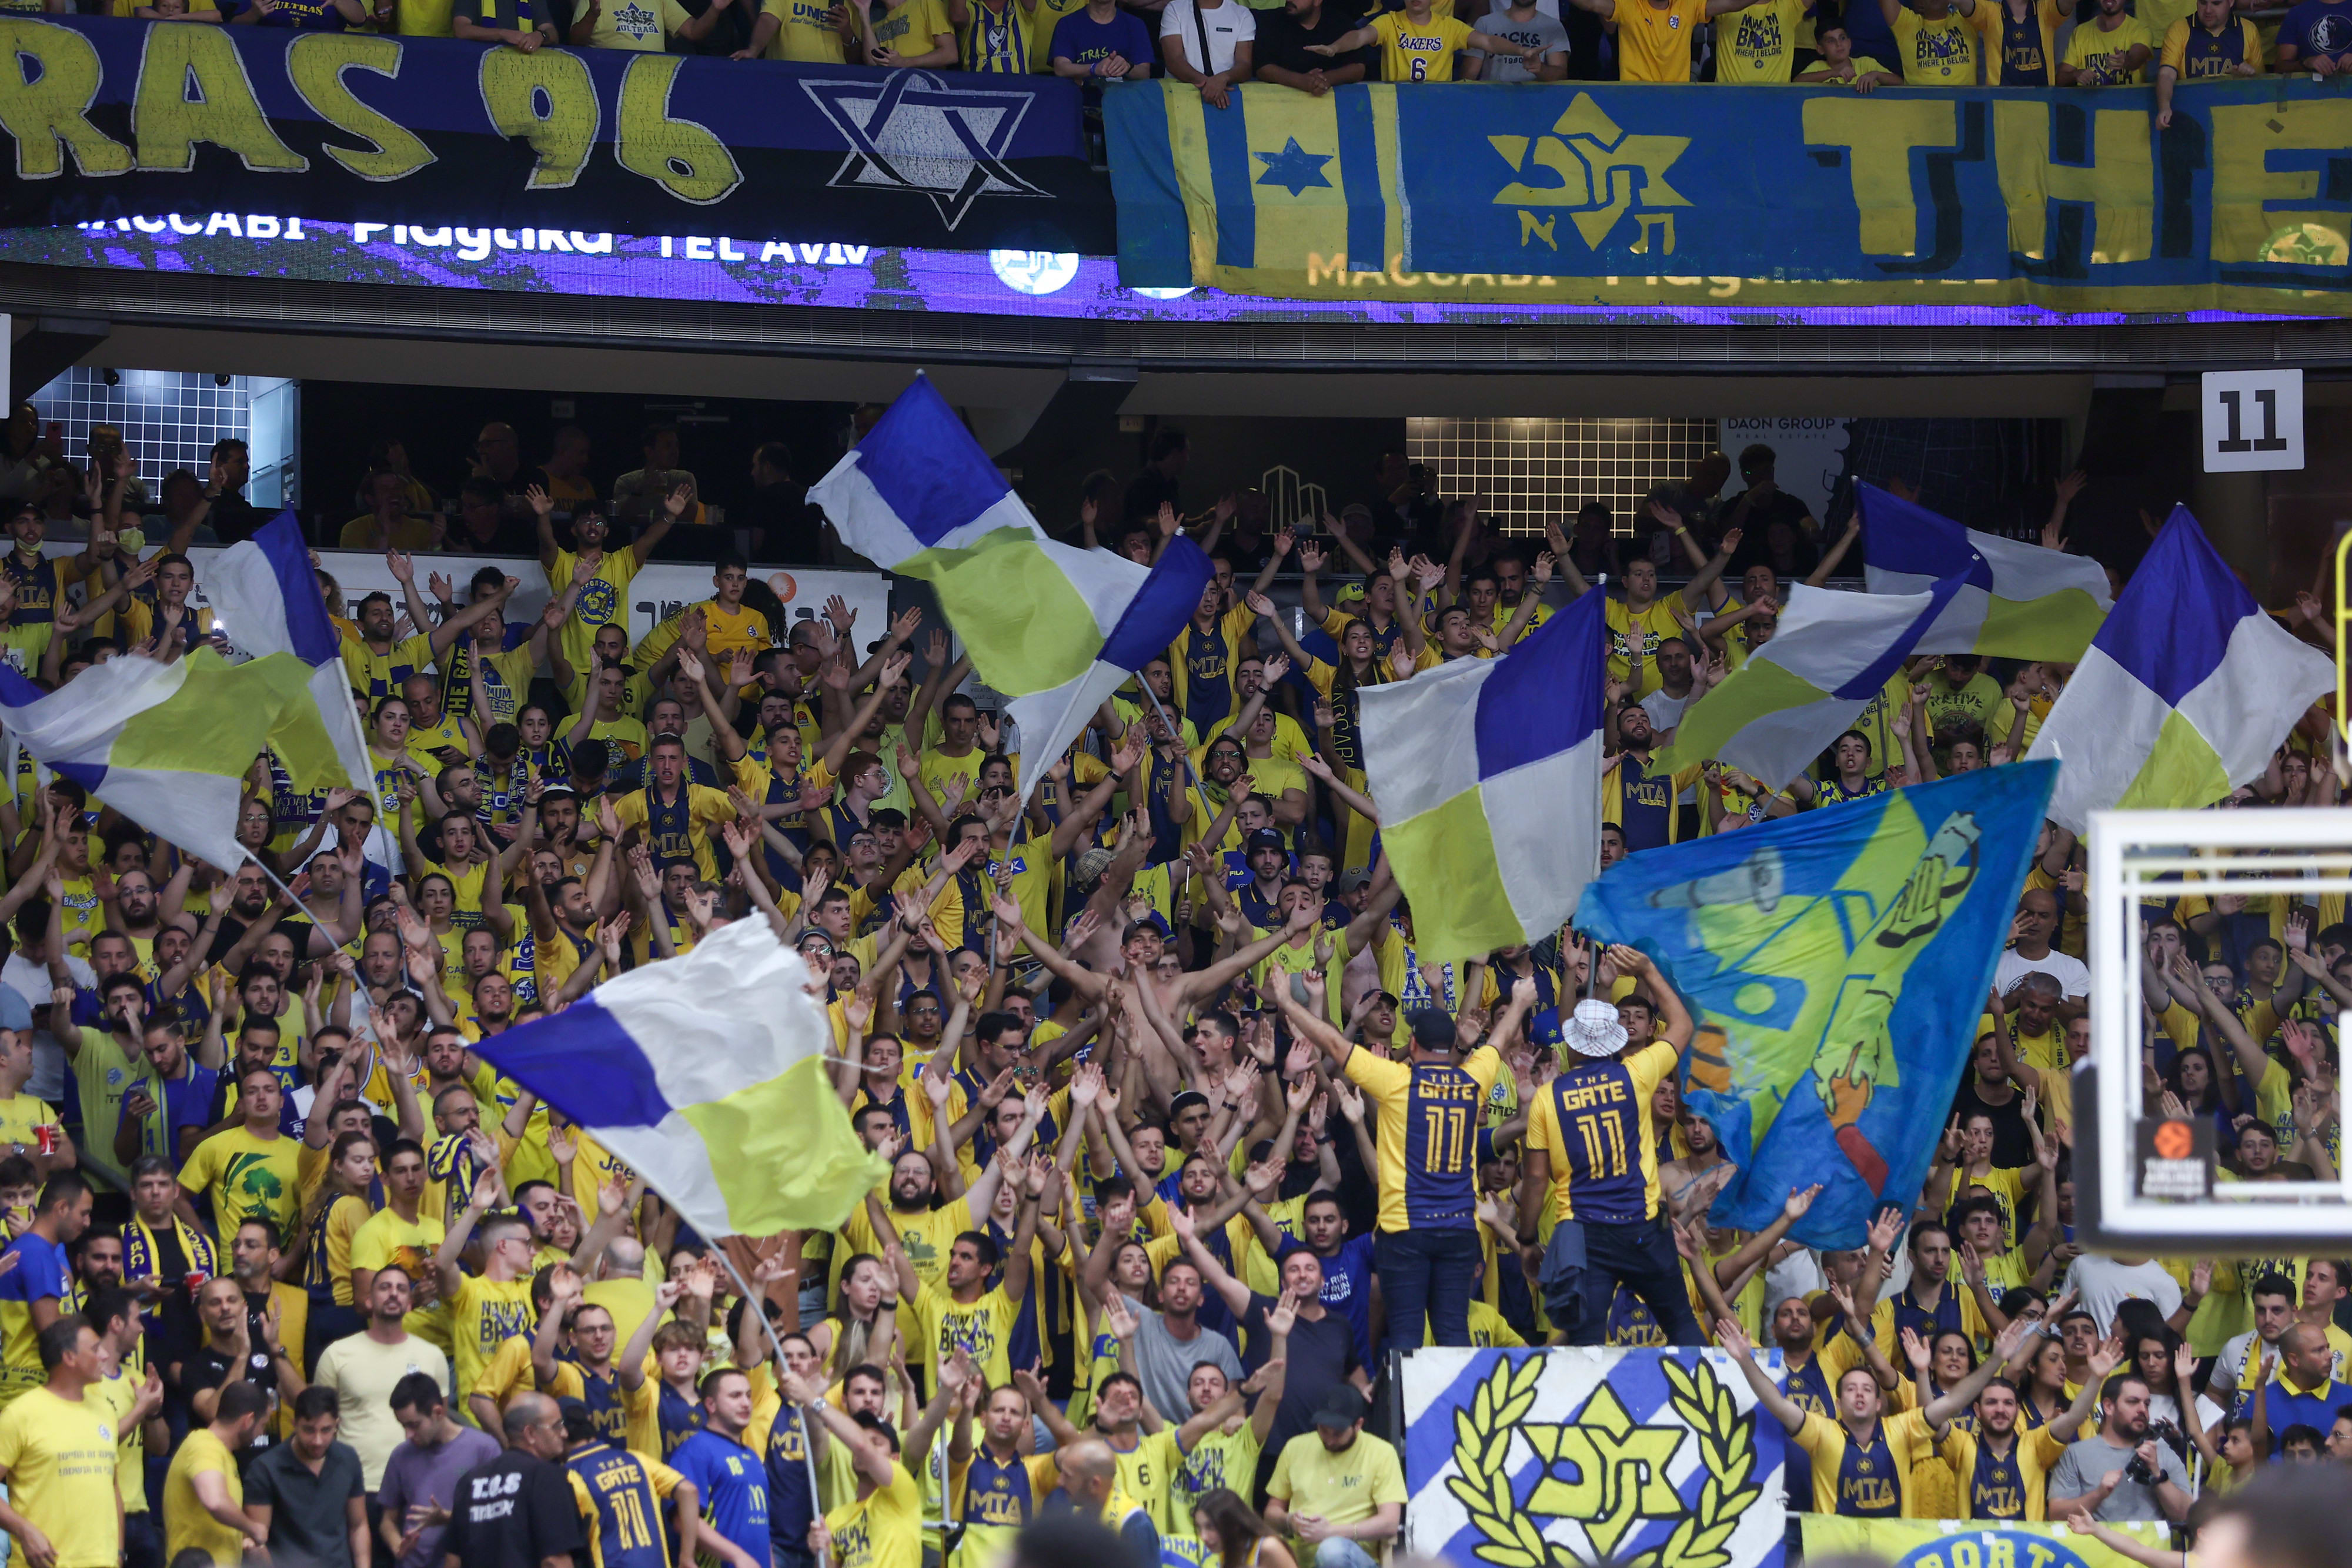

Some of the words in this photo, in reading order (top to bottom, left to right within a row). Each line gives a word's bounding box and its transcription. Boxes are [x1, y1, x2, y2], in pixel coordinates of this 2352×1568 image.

[275, 1, 323, 16] ULTRAS
[620, 25, 654, 33] ULTRAS
[1736, 26, 1782, 48] BACK
[1397, 32, 1443, 51] LAKERS
[1760, 46, 1782, 57] BELONG
[1916, 37, 1969, 59] BACK
[1077, 46, 1109, 63] TRAS
[1917, 59, 1940, 69] WHERE
[1946, 56, 1970, 65] BELONG
[2005, 46, 2042, 64] MTA
[1411, 56, 1427, 82] 6
[2191, 57, 2233, 76] MTA
[478, 45, 745, 206] 96
[1801, 96, 2352, 265] THE
[76, 212, 306, 240] CCABI
[1728, 419, 1772, 429] DAON
[1778, 419, 1835, 429] GROUP
[2218, 389, 2287, 453] 11
[1188, 656, 1227, 673] MTA
[448, 685, 469, 718] THE
[1865, 700, 1890, 715] BELNG
[1332, 691, 1355, 763] ACCABI
[1625, 781, 1668, 801] MTA
[649, 833, 690, 853] MTA
[988, 860, 1023, 875] FX
[1403, 998, 1458, 1013] MACBI
[1418, 1079, 1476, 1101] GATE
[1430, 1074, 1461, 1084] THE
[1574, 1074, 1609, 1086] THE
[1562, 1080, 1627, 1111] GATE
[1425, 1105, 1466, 1174] 11
[1576, 1110, 1628, 1179] 11
[599, 1155, 636, 1181] Jee
[1329, 1272, 1348, 1285] RUN
[1331, 1281, 1351, 1293] RUN
[1329, 1289, 1351, 1302] RUN
[1616, 1324, 1669, 1347] MTA
[593, 1407, 626, 1432] MT
[771, 1430, 804, 1452] MT
[594, 1464, 642, 1492] GATE
[1138, 1464, 1151, 1486] 6
[1843, 1477, 1896, 1503] MTA
[1975, 1483, 2021, 1511] MTA
[968, 1489, 1022, 1524] MTA
[609, 1487, 652, 1550] 11
